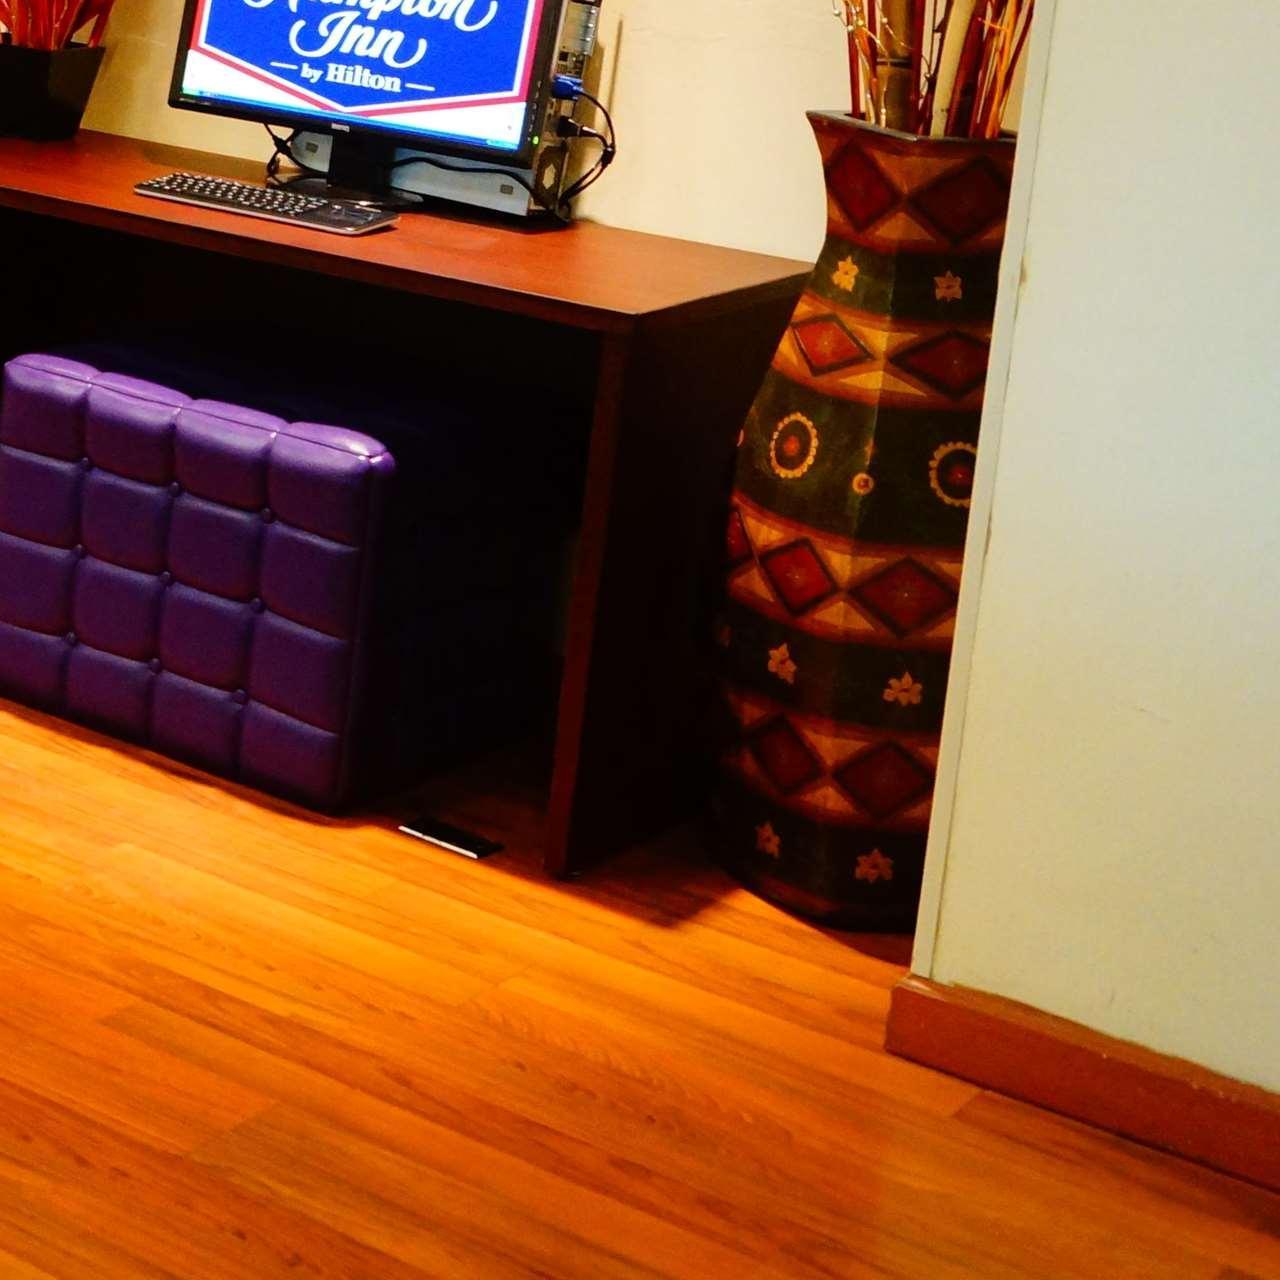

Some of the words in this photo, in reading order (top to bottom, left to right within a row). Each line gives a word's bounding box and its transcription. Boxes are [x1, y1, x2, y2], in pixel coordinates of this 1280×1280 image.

[289, 10, 428, 69] Inn
[300, 62, 324, 84] by
[325, 62, 403, 93] Hilton
